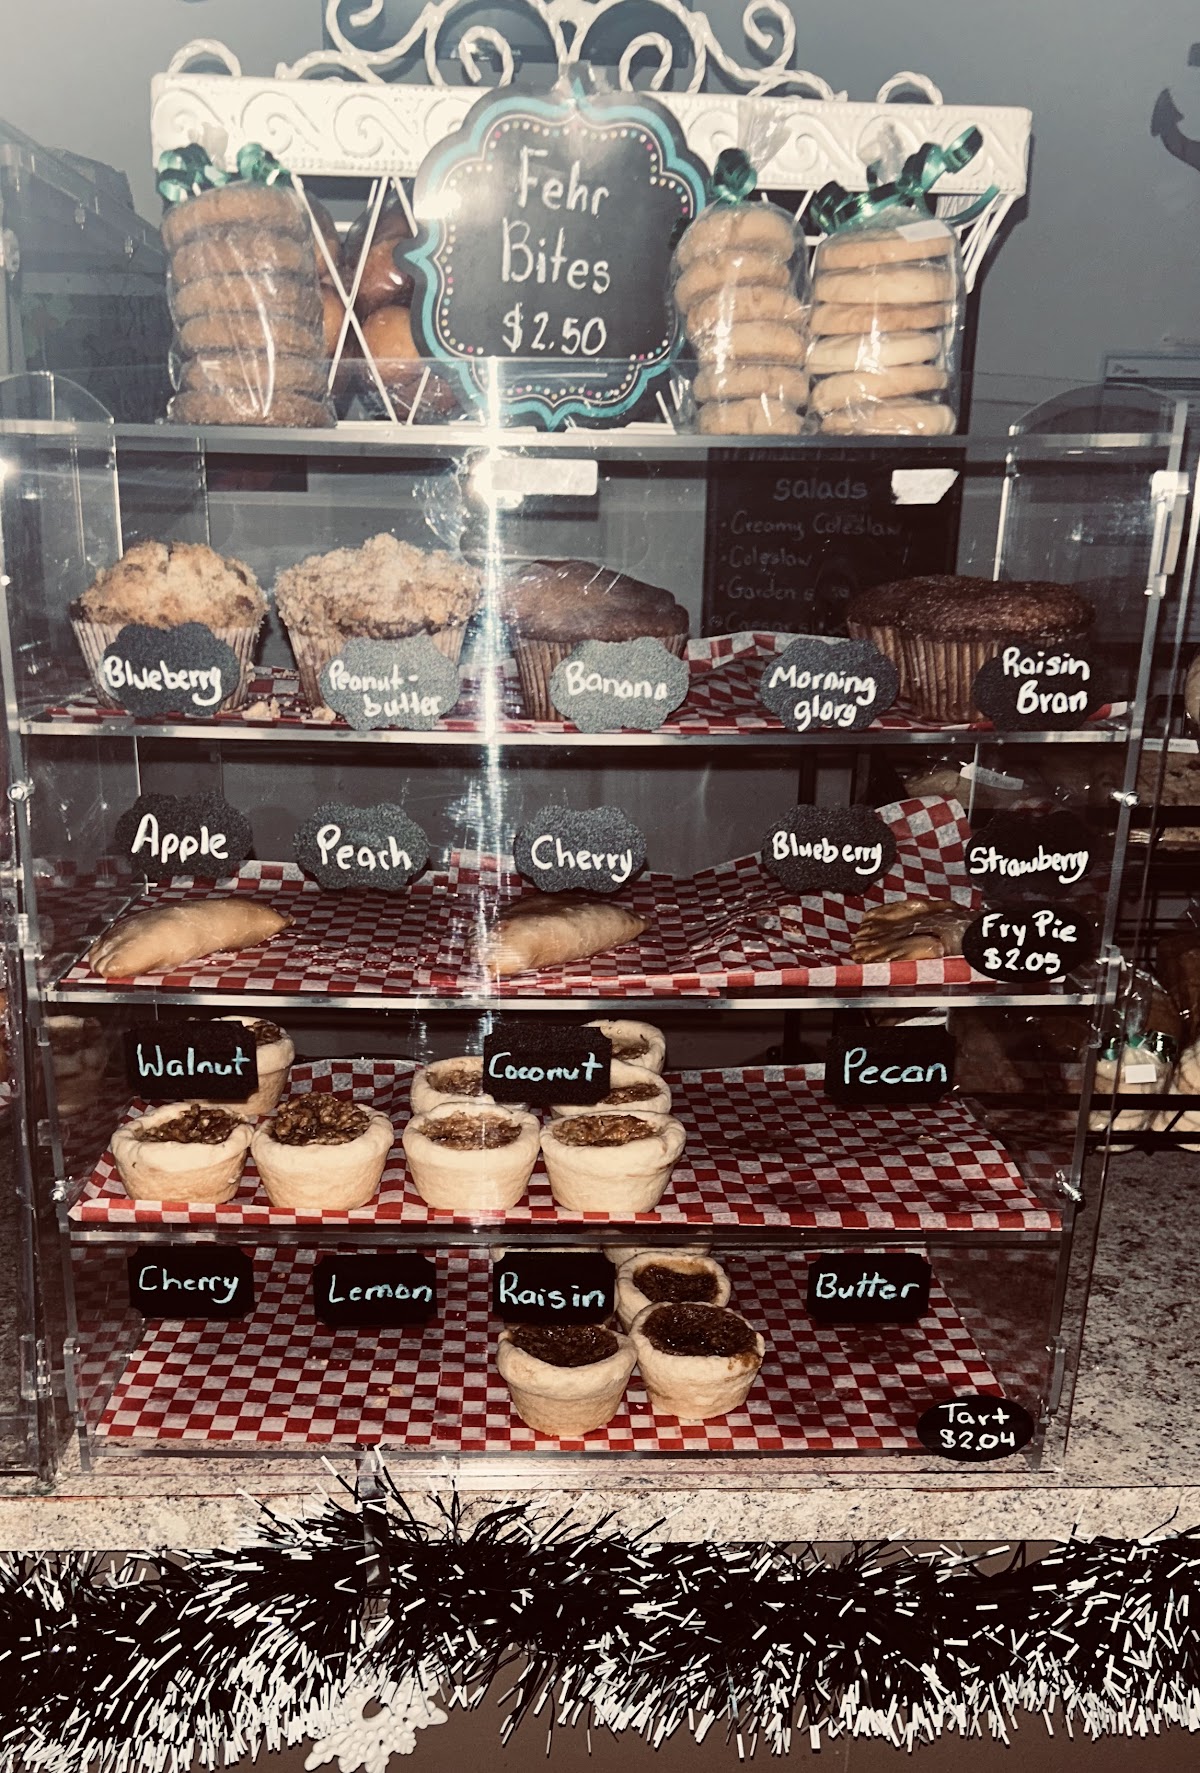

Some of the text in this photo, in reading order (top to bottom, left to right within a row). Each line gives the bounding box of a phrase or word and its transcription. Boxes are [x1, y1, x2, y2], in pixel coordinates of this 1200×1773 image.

[518, 145, 609, 215] Fehr
[502, 217, 611, 295] Bites
[502, 302, 607, 355] $2.50
[102, 655, 222, 707] Blueberry
[565, 660, 668, 701] Banana
[1002, 646, 1091, 681] Raisin
[363, 691, 443, 718] butter
[768, 665, 877, 706] Morning
[1016, 679, 1088, 715] Bran
[793, 694, 858, 732] glory
[131, 813, 229, 864] Apple
[316, 824, 413, 871] Peach
[771, 830, 883, 876] Blueberry
[531, 835, 633, 884] Cherry
[969, 844, 1089, 885] Strawberry
[982, 909, 1078, 947] Fry Pie
[983, 947, 1061, 975] $2.05
[136, 1043, 251, 1077] Walnut
[488, 1051, 604, 1083] Coconut
[844, 1047, 948, 1085] Pecan
[138, 1265, 239, 1304] Cherry
[328, 1274, 433, 1303] Lemon
[499, 1271, 606, 1309] Raisin
[816, 1271, 920, 1300] Butter
[938, 1402, 1010, 1426] Tart
[939, 1428, 1016, 1451] $2.04
